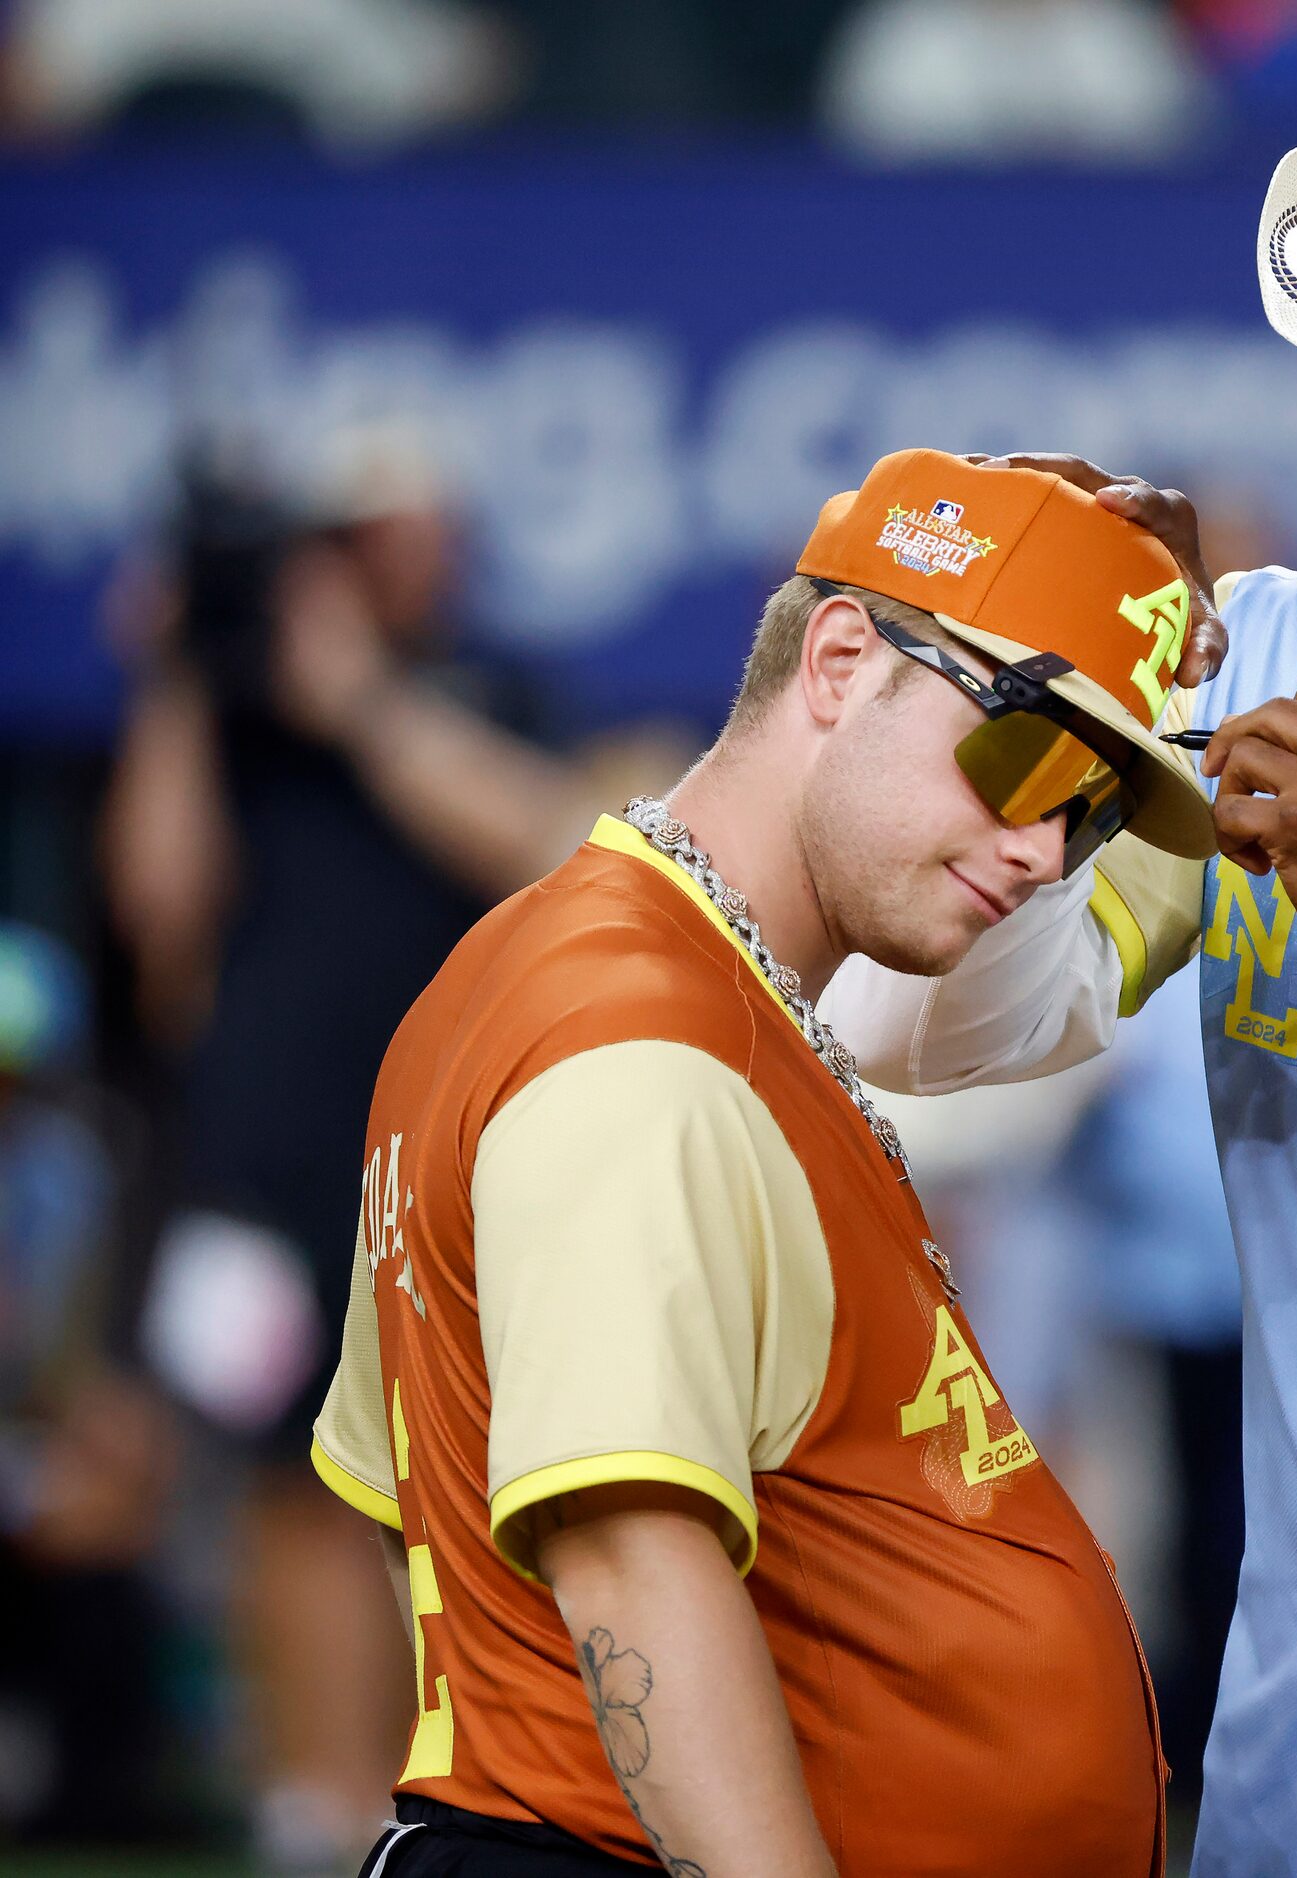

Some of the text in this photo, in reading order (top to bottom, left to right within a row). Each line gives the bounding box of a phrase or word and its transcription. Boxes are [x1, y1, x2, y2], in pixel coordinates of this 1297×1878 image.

[875, 535, 967, 577] SOFTBALL GAME
[882, 521, 981, 566] CELEBRITY
[901, 555, 930, 573] 2024
[1236, 1015, 1287, 1047] 2024
[977, 1436, 1031, 1475] 2024
